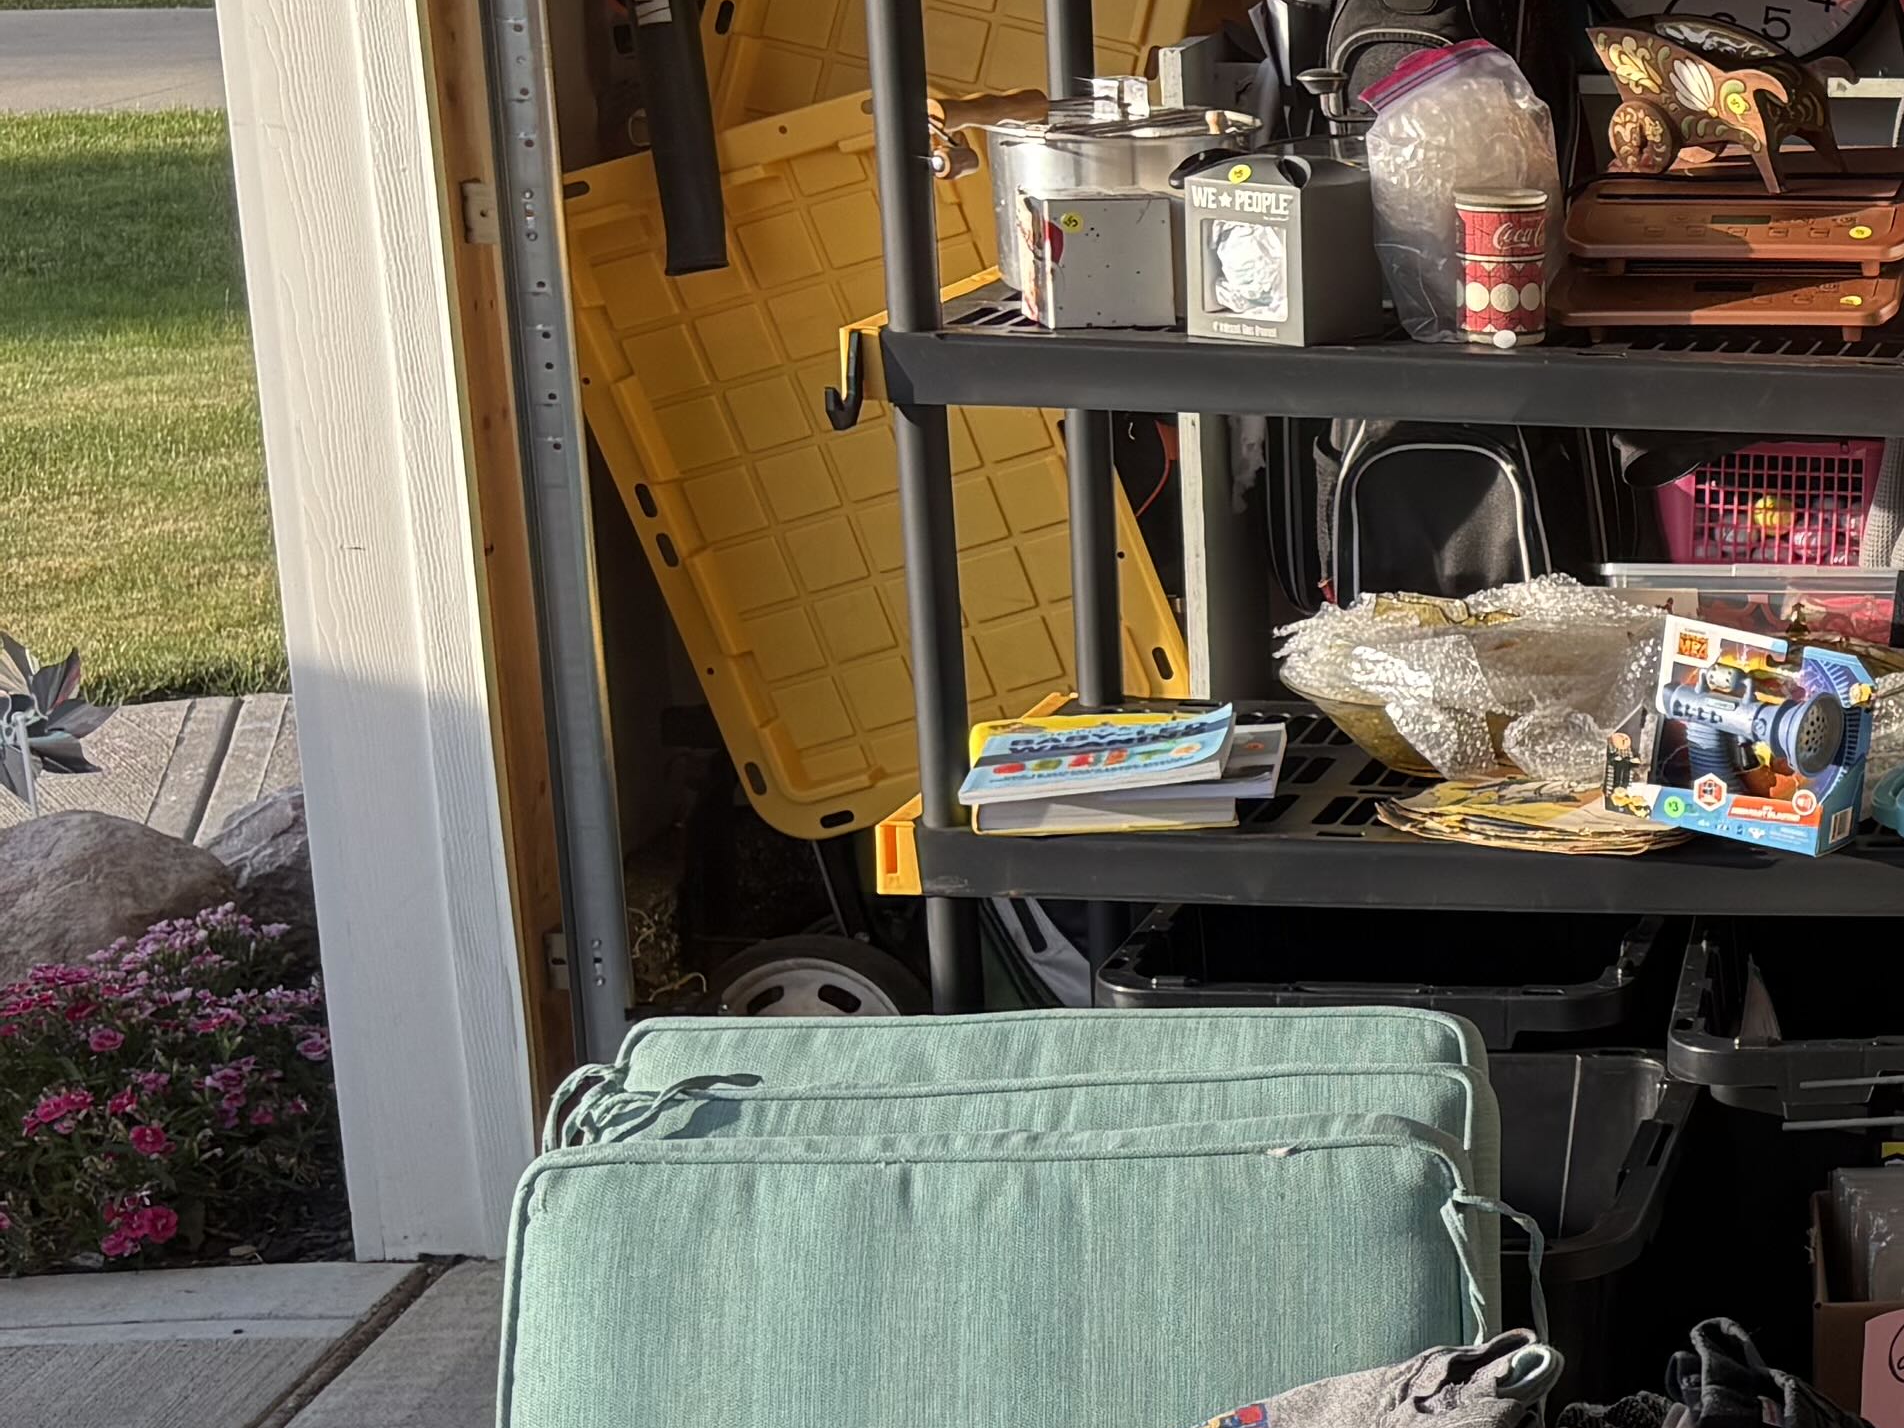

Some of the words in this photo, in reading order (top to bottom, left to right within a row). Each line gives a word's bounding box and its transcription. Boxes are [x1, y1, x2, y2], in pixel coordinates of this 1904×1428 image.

[1760, 5, 1792, 42] 5
[1190, 185, 1218, 210] WE
[1233, 189, 1294, 216] PEOPLE
